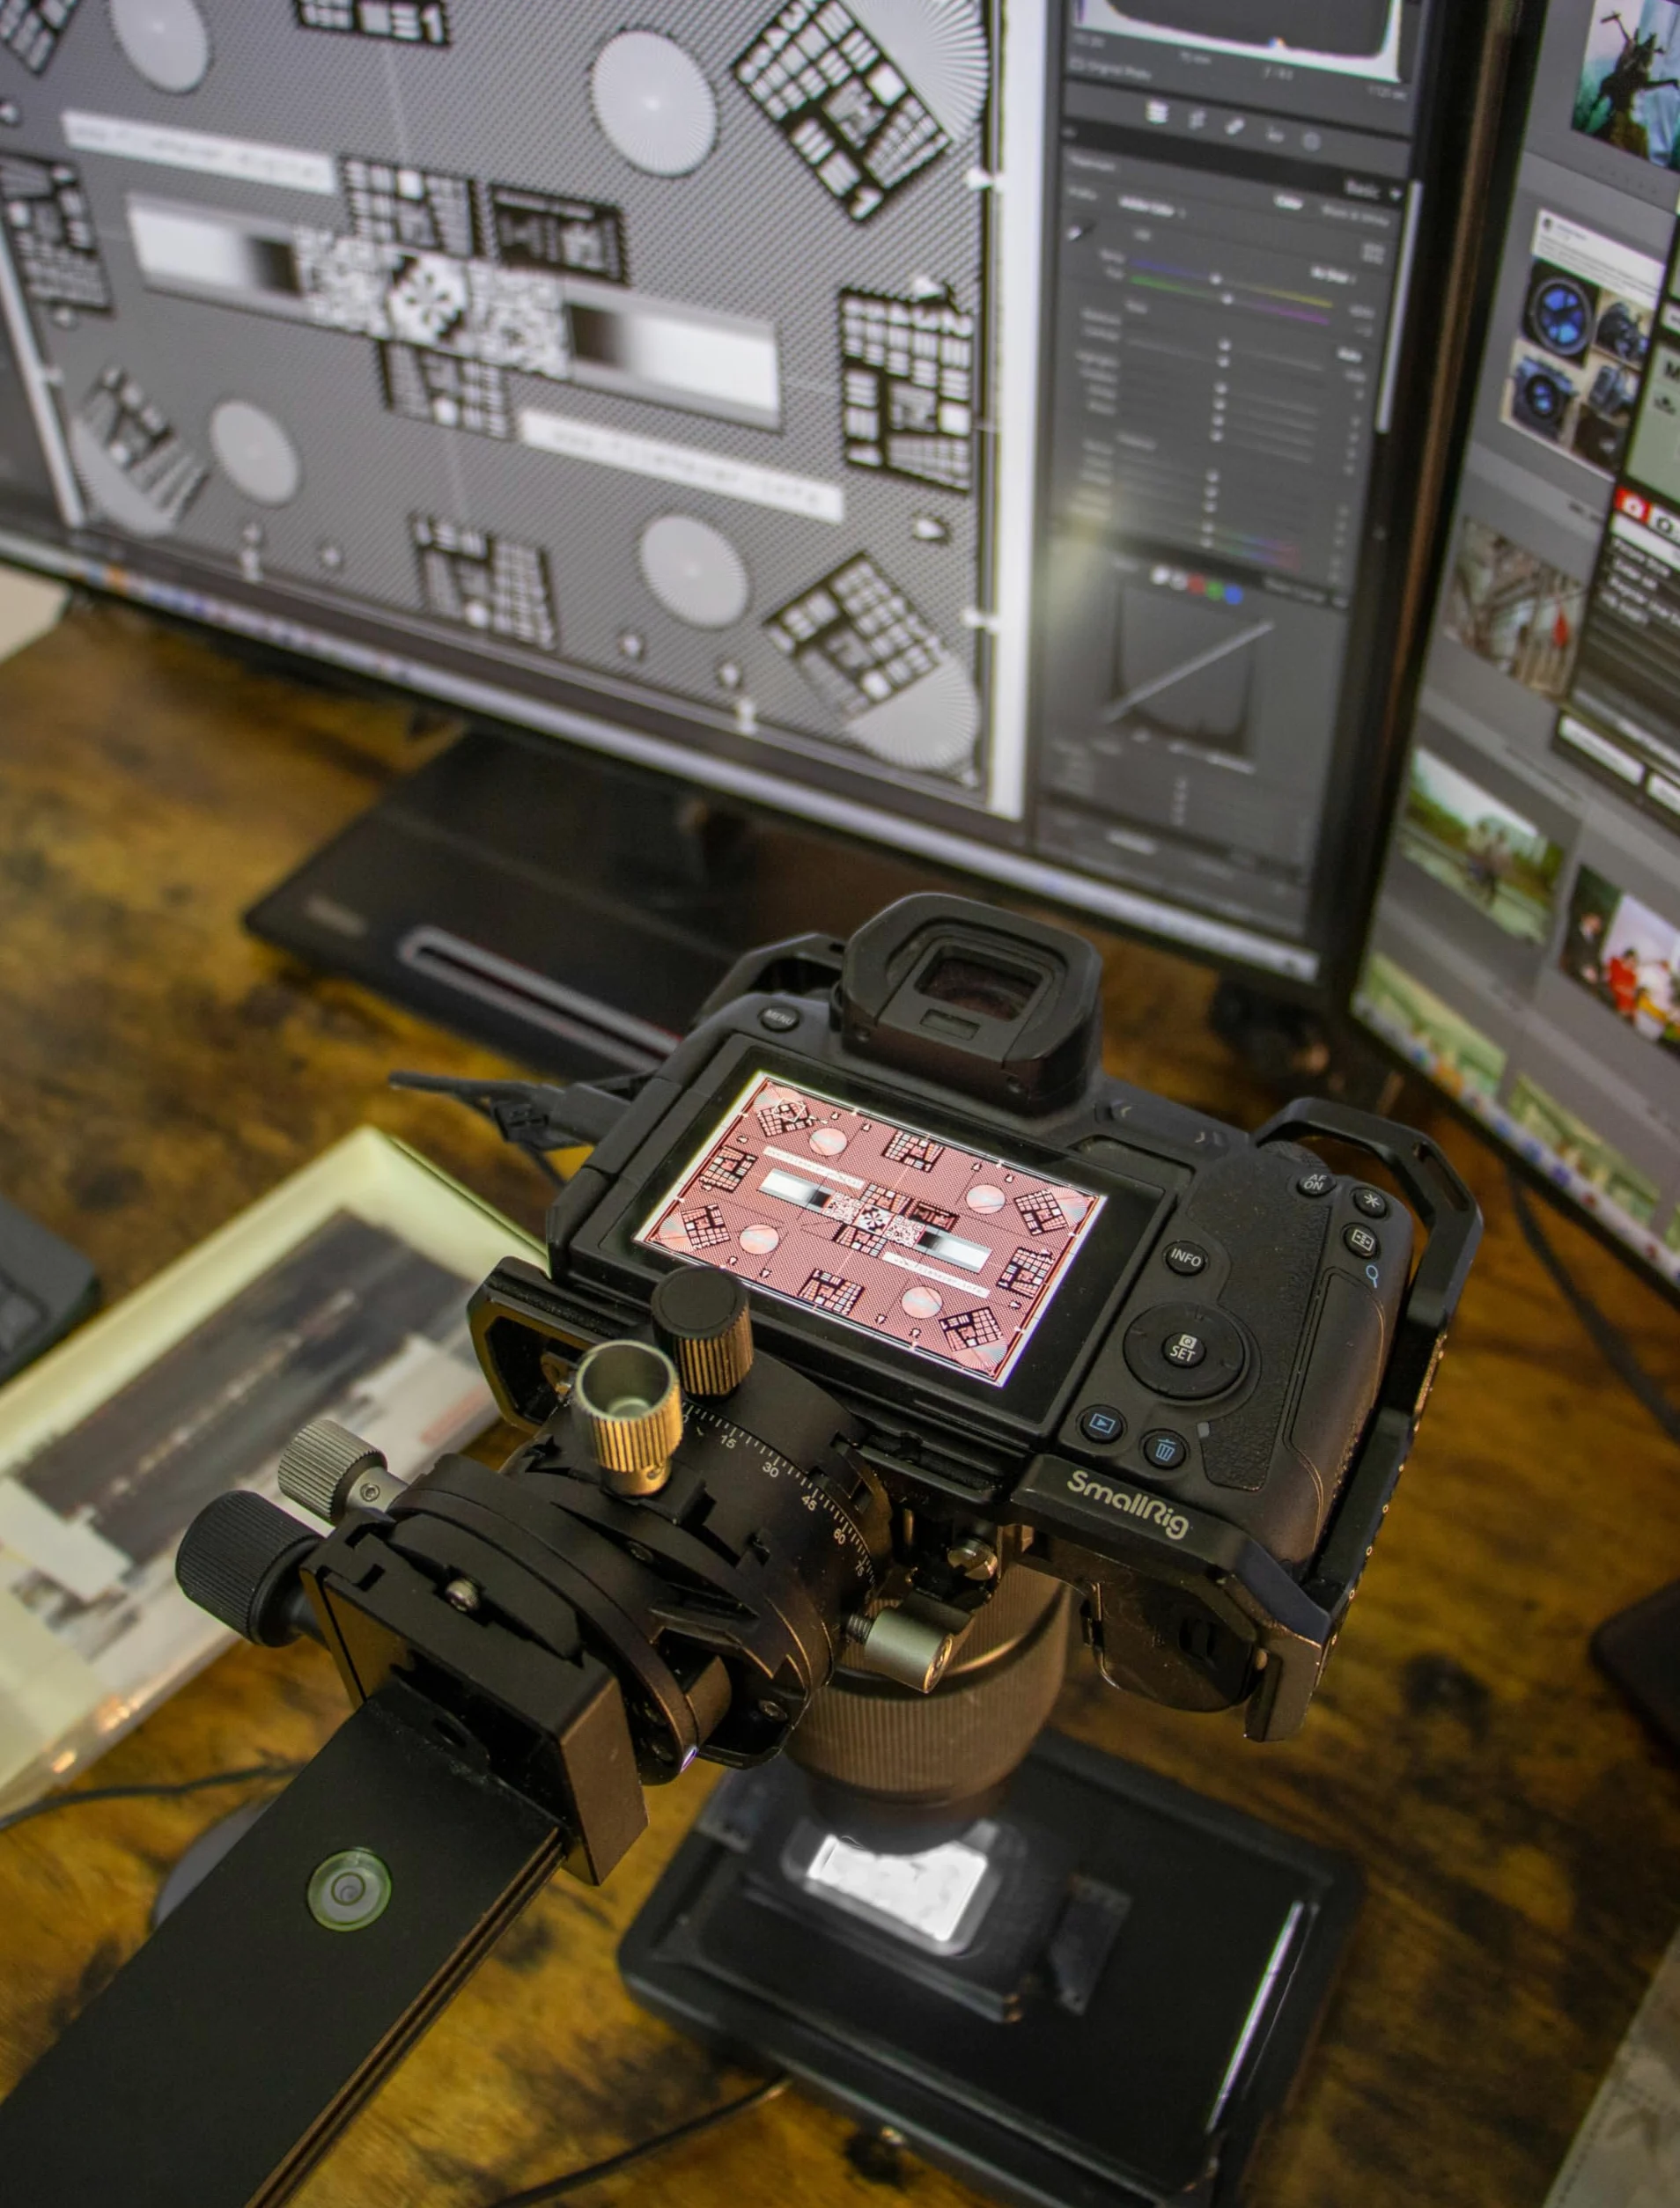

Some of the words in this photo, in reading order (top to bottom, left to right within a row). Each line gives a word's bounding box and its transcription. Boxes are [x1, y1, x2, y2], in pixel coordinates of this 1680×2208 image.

[765, 1009, 796, 1026] MENU
[1303, 1180, 1324, 1191] ON
[1171, 1248, 1202, 1267] INFO
[1169, 1345, 1196, 1362] SET
[720, 1435, 737, 1449] 15
[762, 1461, 779, 1478] 30
[801, 1496, 818, 1511] 45
[833, 1527, 846, 1545] 60
[1066, 1469, 1190, 1541] SmallRig
